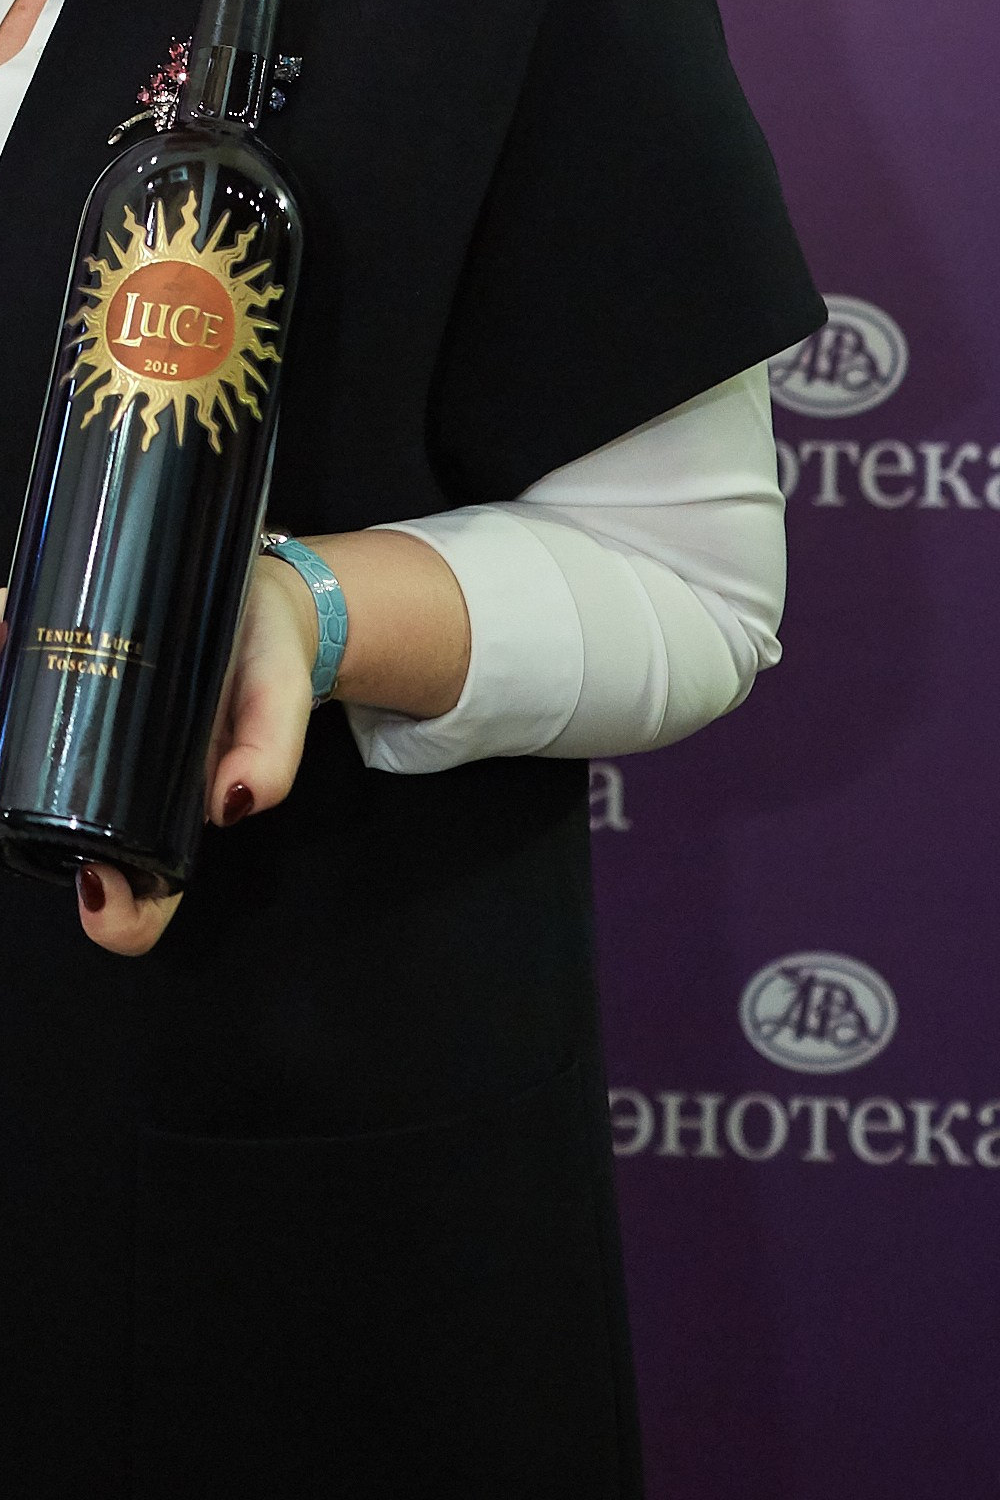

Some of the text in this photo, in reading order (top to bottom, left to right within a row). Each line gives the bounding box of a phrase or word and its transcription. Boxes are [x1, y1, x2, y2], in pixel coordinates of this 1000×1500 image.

[111, 291, 224, 350] LUCE
[143, 358, 179, 376] 2015
[37, 627, 93, 646] TENUTA
[47, 654, 118, 679] TOSCANA
